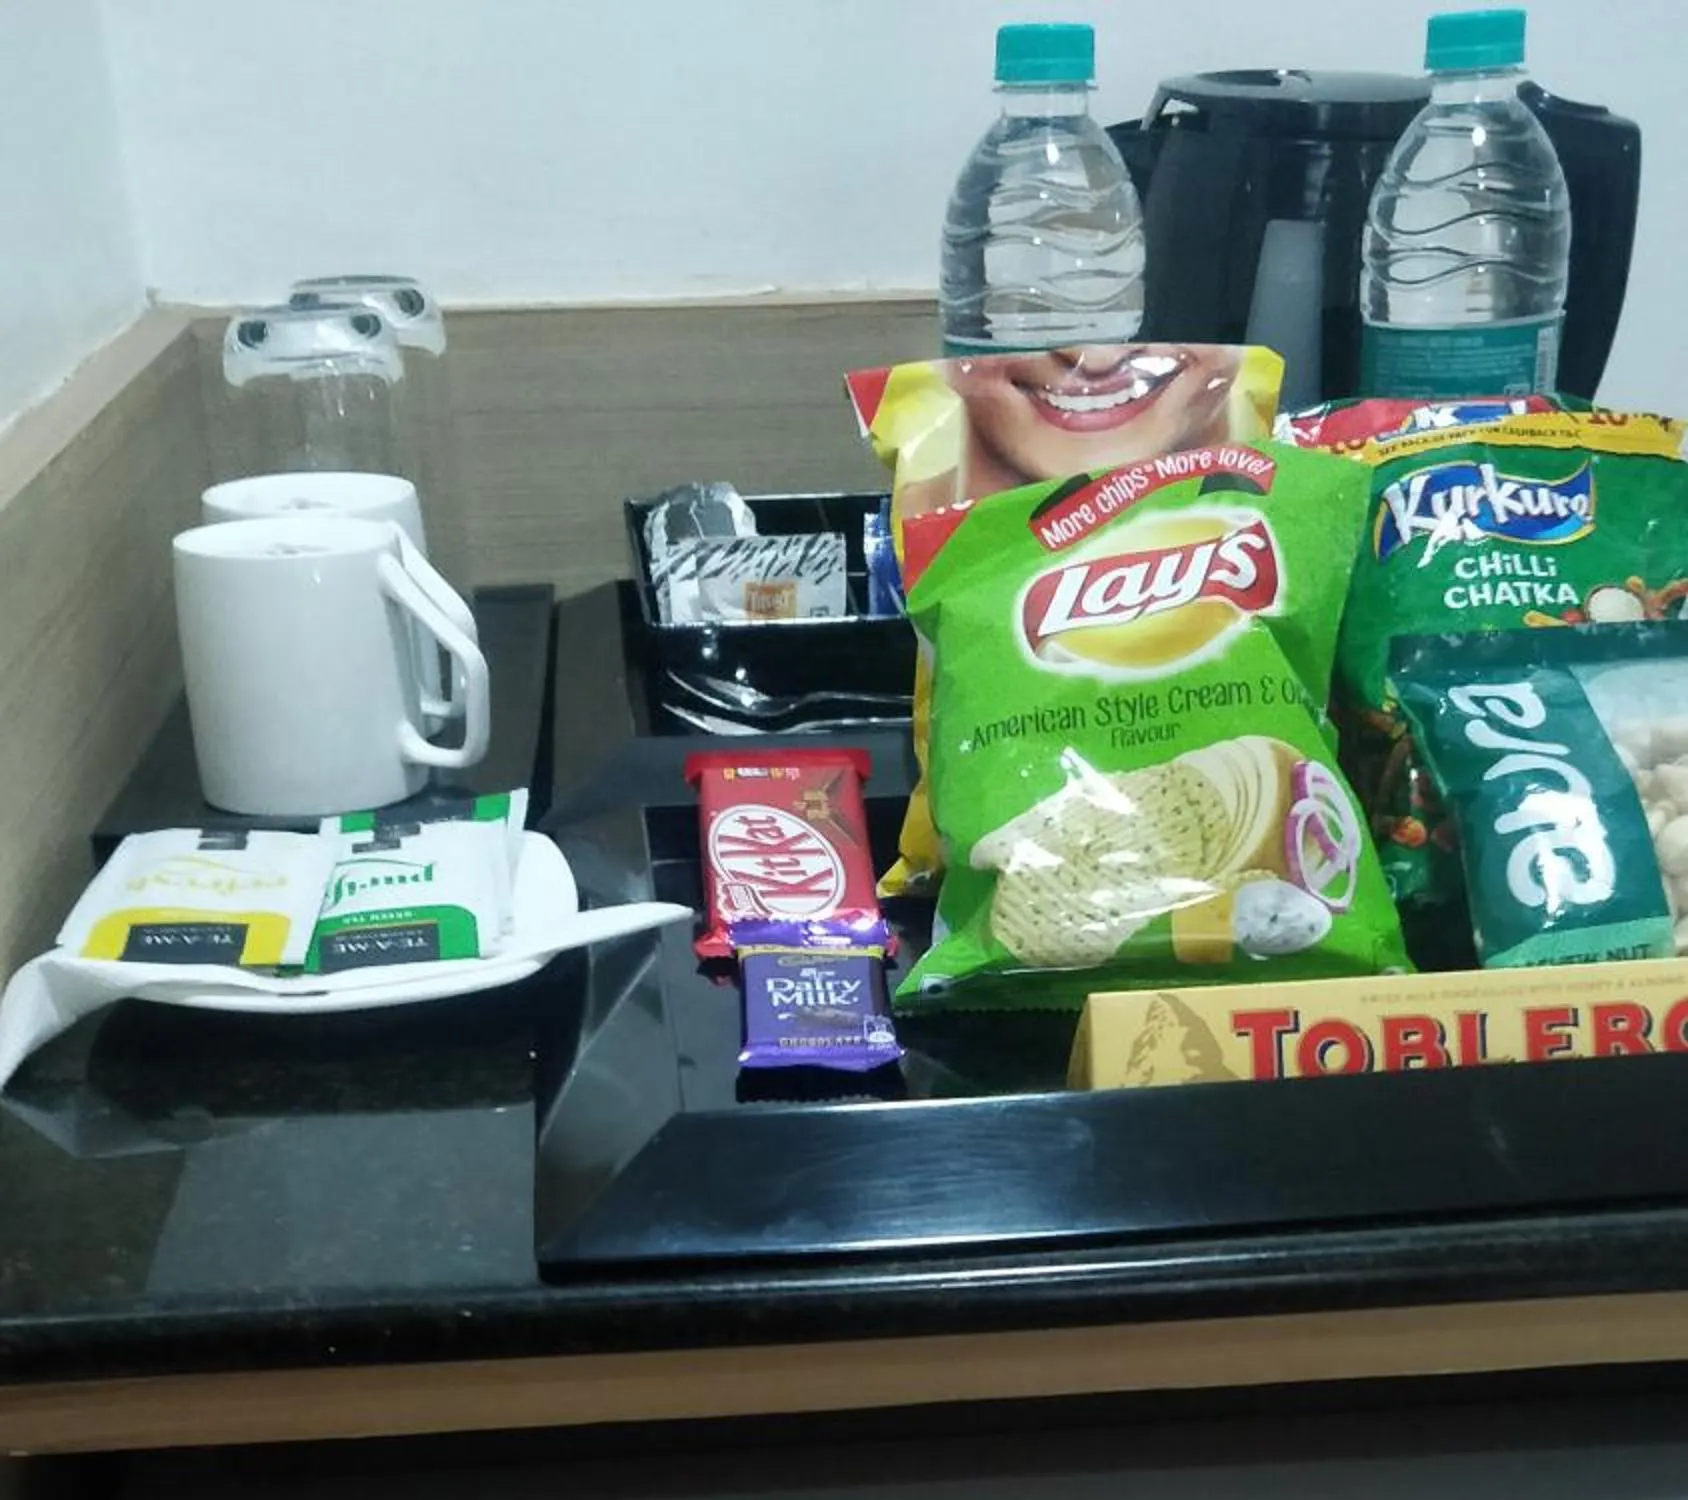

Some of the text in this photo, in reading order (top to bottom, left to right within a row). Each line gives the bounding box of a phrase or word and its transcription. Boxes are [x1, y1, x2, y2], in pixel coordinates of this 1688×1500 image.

[1040, 504, 1097, 548] More
[1154, 450, 1213, 480] More
[1443, 581, 1580, 609] CHATKA
[971, 703, 1086, 751] American
[1094, 692, 1161, 728] Style
[1168, 680, 1251, 715] Cream
[1111, 721, 1182, 748] Flavour
[766, 967, 862, 993] Dairy
[770, 988, 860, 1008] Milk
